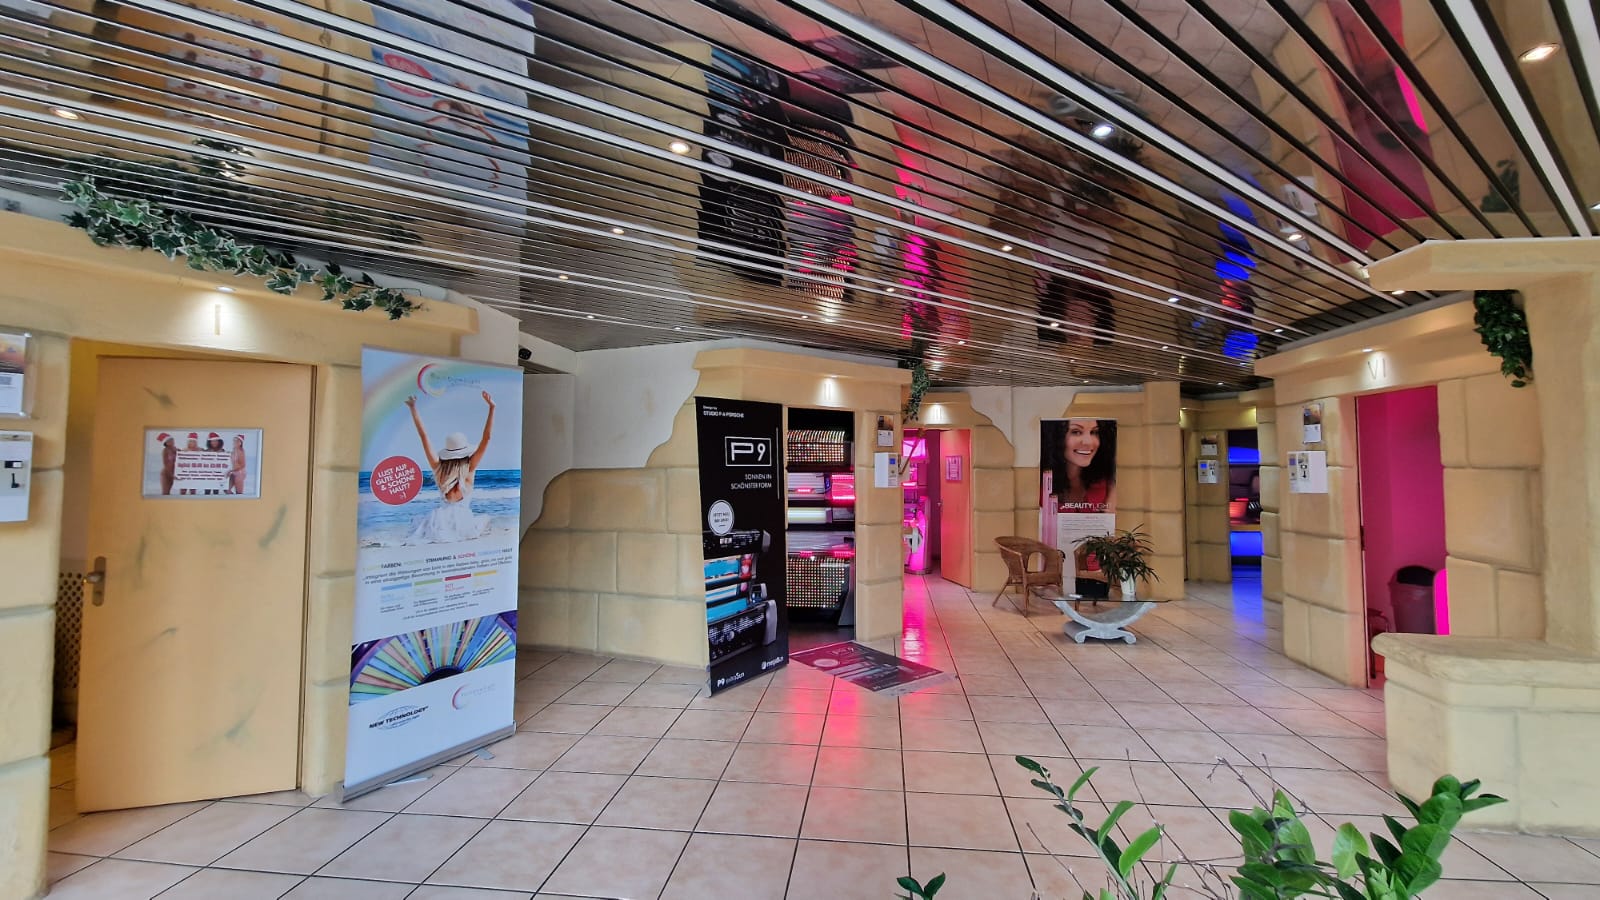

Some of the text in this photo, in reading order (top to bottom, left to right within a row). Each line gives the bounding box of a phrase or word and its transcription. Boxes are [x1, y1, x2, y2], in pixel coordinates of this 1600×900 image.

[1367, 358, 1386, 380] VI
[730, 442, 766, 462] P9
[376, 467, 415, 485] GUTE LAUNE
[378, 464, 407, 478] LUST AUF
[368, 719, 385, 729] NEW
